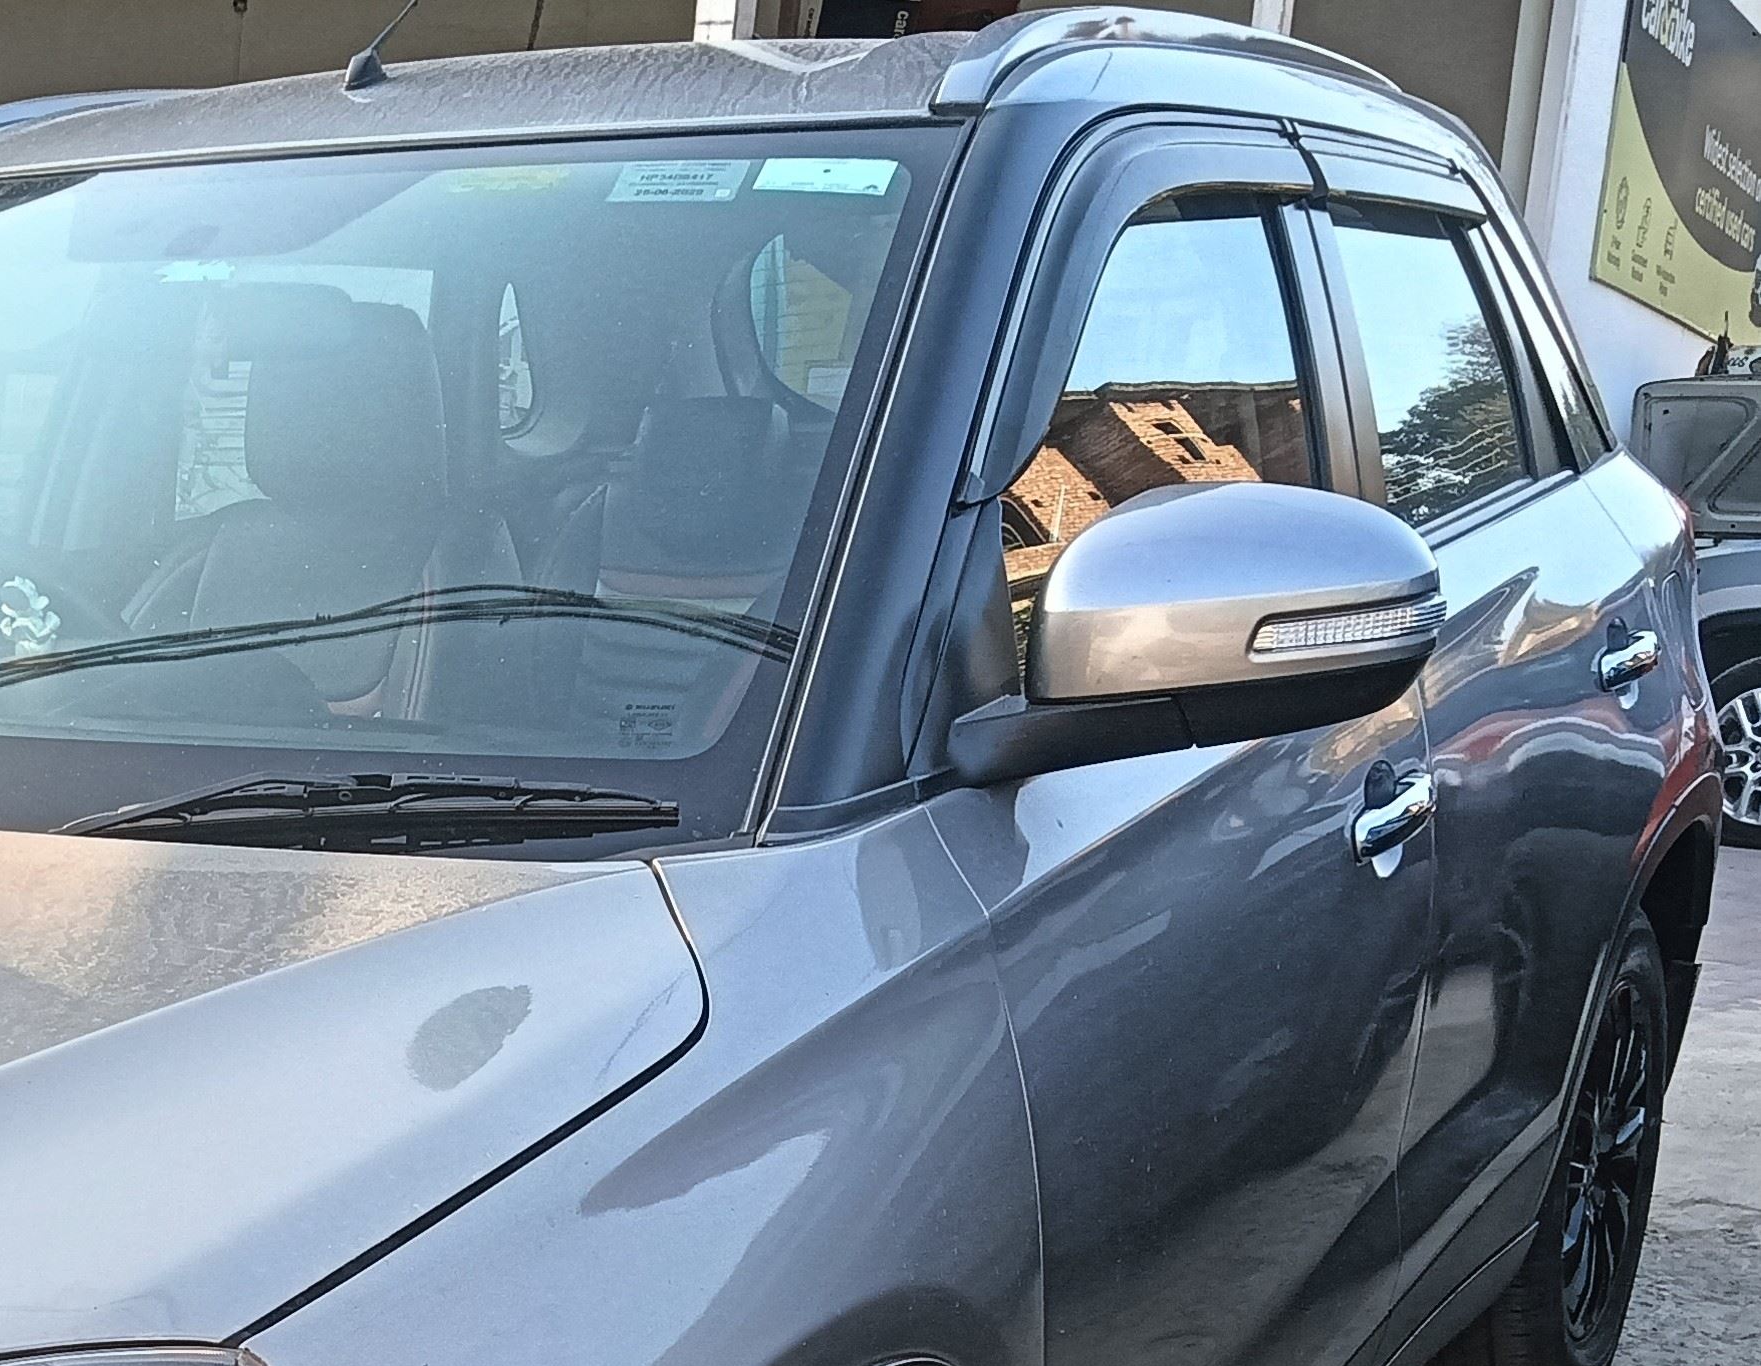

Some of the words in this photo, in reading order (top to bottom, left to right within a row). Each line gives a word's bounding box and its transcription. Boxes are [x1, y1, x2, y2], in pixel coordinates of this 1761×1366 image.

[1695, 187, 1729, 231] certified
[1725, 206, 1745, 243] used
[1740, 222, 1756, 253] cars
